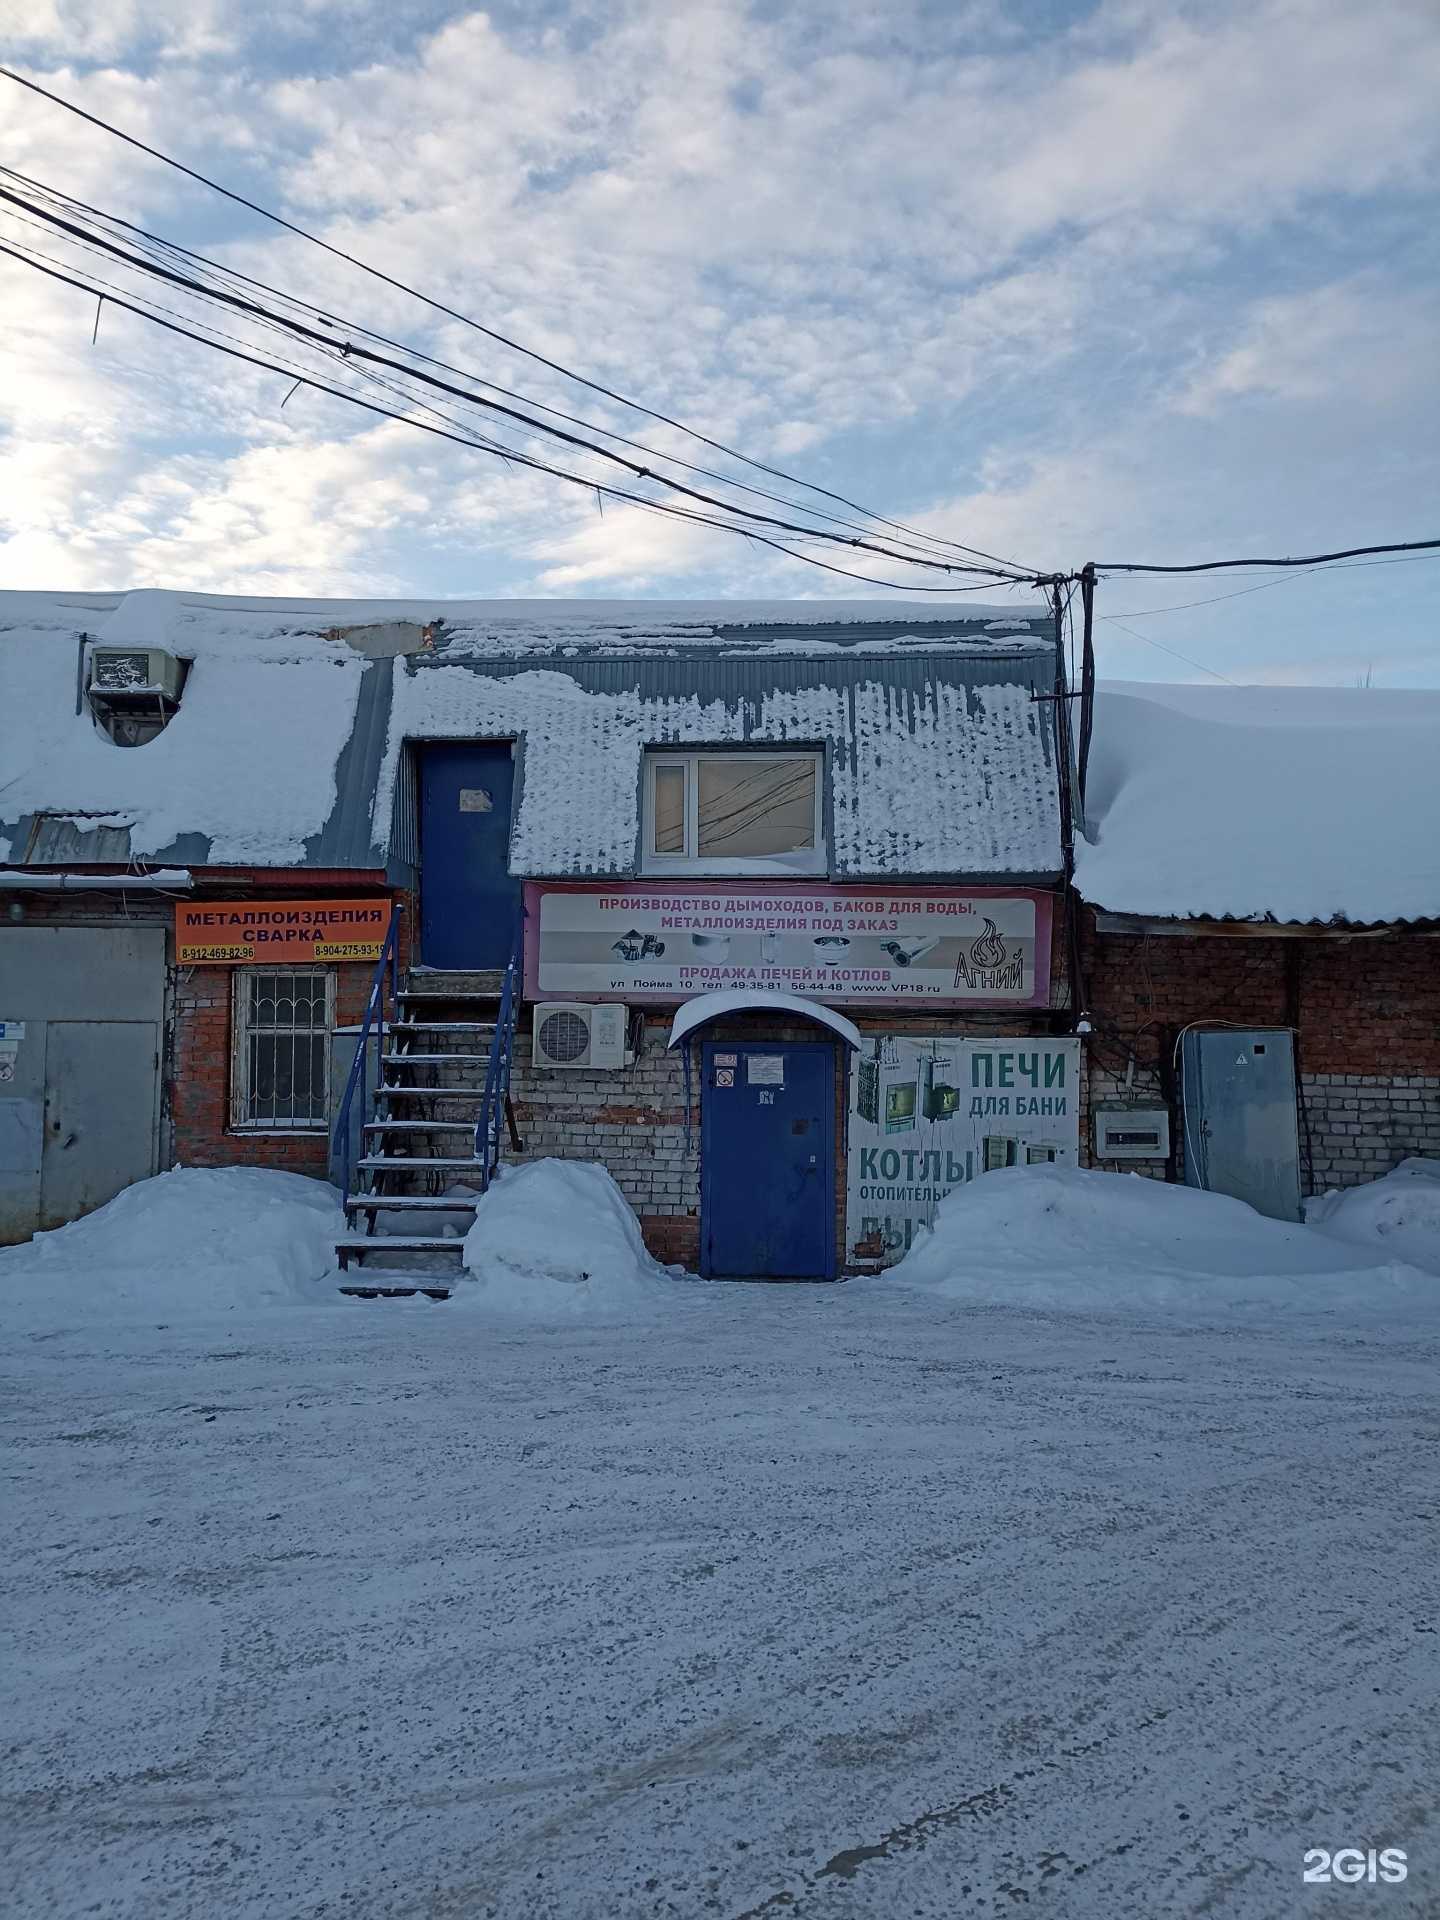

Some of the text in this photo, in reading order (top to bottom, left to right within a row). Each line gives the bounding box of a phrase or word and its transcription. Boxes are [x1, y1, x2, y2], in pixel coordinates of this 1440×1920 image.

[599, 898, 977, 915] ПРОИЗВОДСТВО ДЫМОХОДОВ, БАКОВ ДЛЯ ВОДЫ,
[185, 909, 383, 926] МЕТАЛЛОИЗДЕЛИЯ
[661, 917, 898, 932] МЕТАЛЛОИЗДЕЛИЯ ПОД ЗАКАЗ
[242, 928, 325, 942] СВАРКА
[182, 947, 254, 959] 8-912-469-82-96
[679, 966, 892, 981] ПРОДАЖА ПЕЧЕЙ И КОТЛОВ
[633, 978, 673, 989] Пойма
[971, 1053, 1066, 1088] ПЕЧИ
[969, 1096, 1067, 1118] ДЛЯ БАНИ
[860, 1148, 973, 1182] КОТЛЫ
